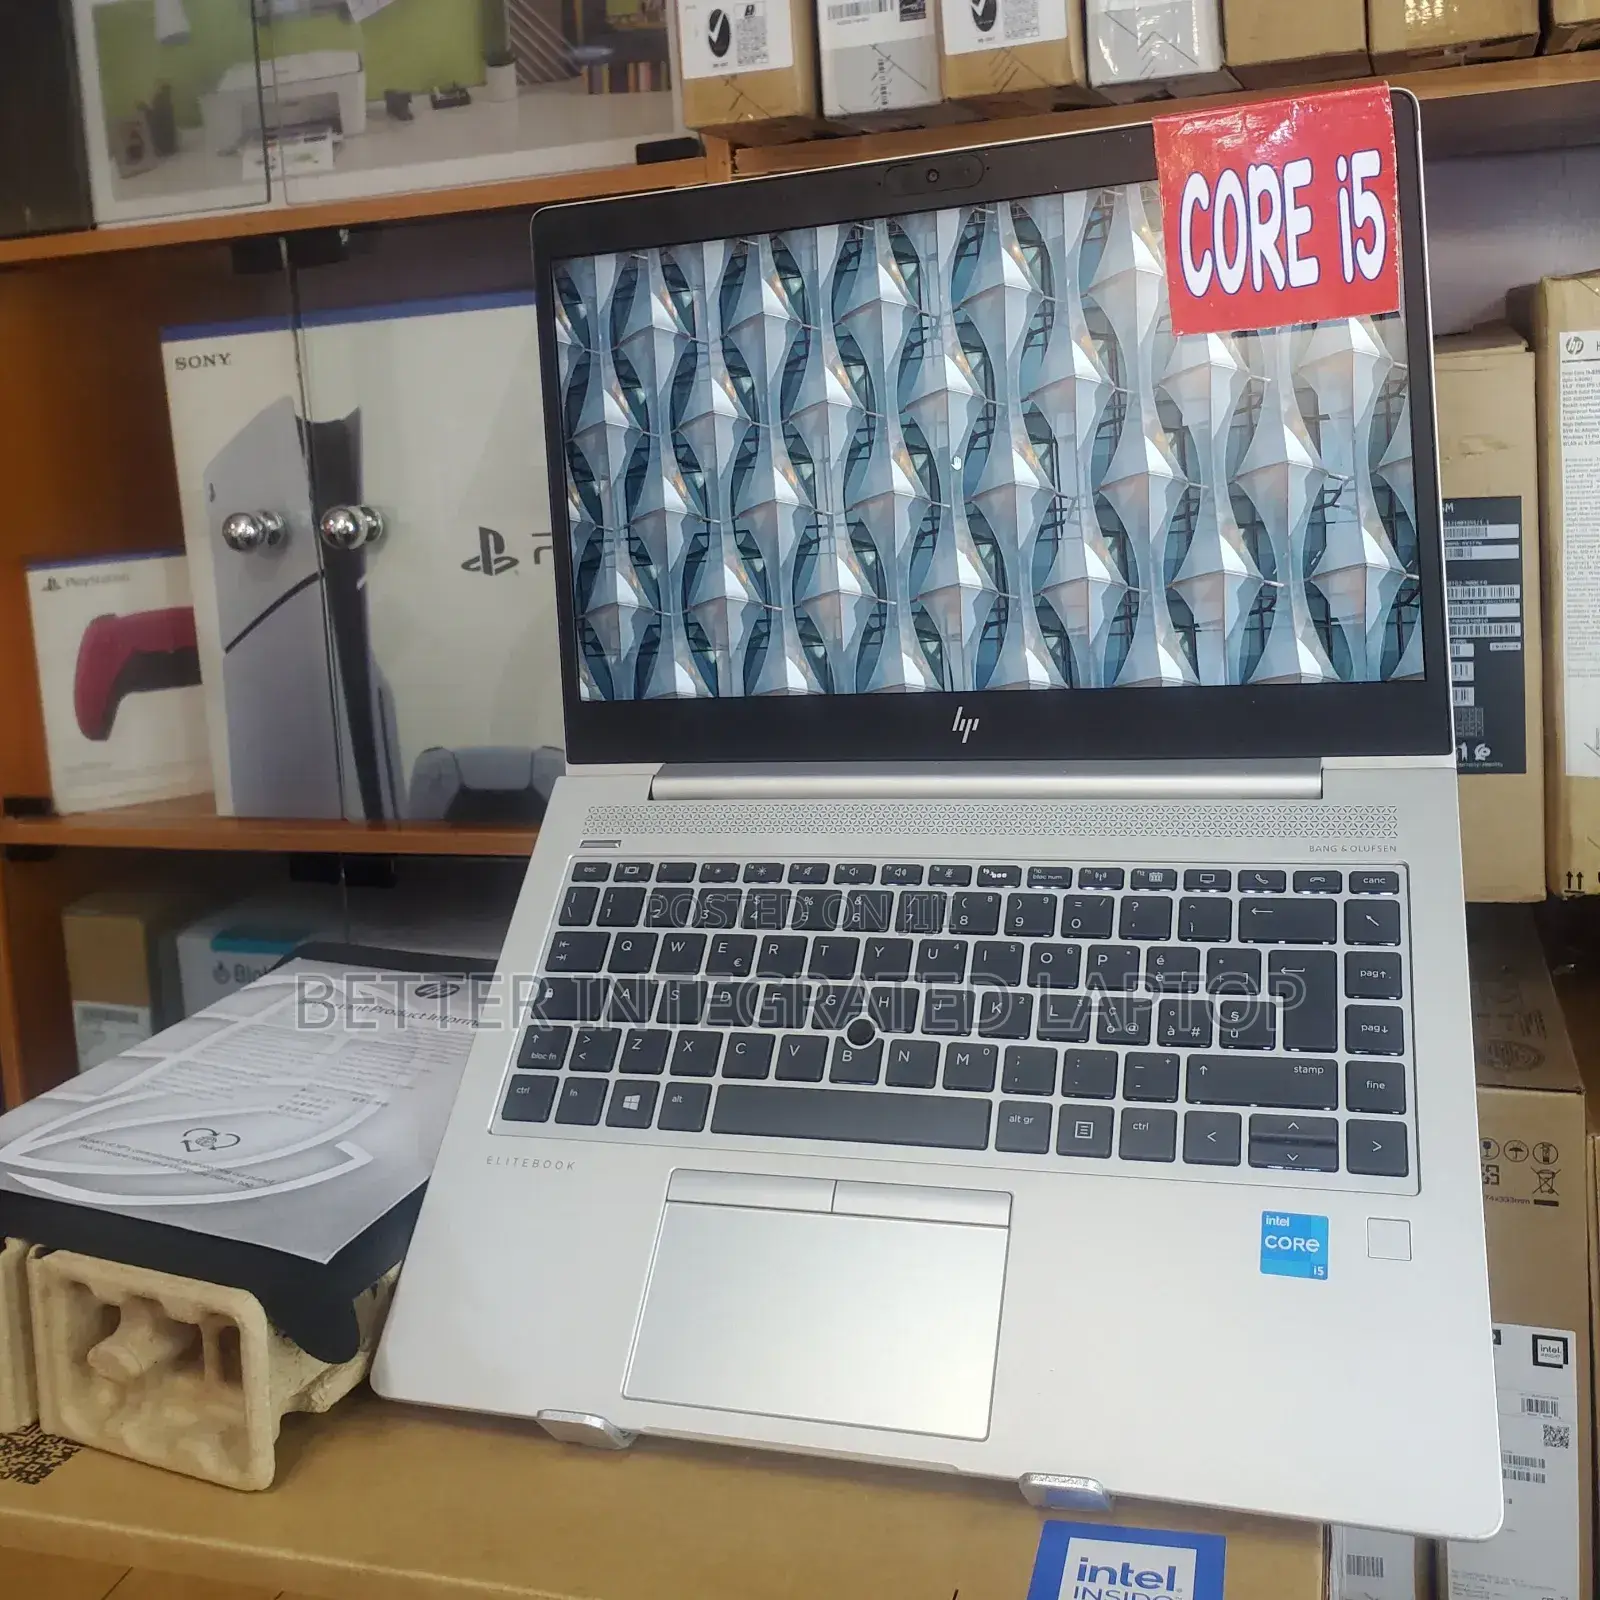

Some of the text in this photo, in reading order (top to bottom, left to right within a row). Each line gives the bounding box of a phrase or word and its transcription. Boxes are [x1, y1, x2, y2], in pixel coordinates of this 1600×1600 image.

[1179, 149, 1387, 298] CORE i5
[175, 352, 232, 370] SONY
[952, 706, 979, 743] hp
[805, 897, 813, 906] %
[855, 896, 862, 906] &
[701, 910, 709, 919] 3
[750, 911, 758, 919] 4
[852, 913, 860, 922] 6
[959, 916, 968, 925] 8
[1015, 917, 1024, 926] 9
[621, 940, 632, 951] Q
[671, 941, 685, 952] W
[718, 942, 728, 953] E
[768, 944, 779, 954] R
[820, 946, 829, 956] T
[875, 947, 884, 958] Y
[928, 948, 938, 959] U
[1041, 952, 1053, 963] O
[734, 958, 743, 967] €
[1098, 955, 1108, 965] P
[620, 988, 631, 999] A
[671, 990, 680, 1001] S
[720, 992, 731, 1002] D
[772, 993, 781, 1003] F
[826, 995, 836, 1006] G
[879, 996, 890, 1008] H
[934, 1000, 942, 1011] J
[369, 1005, 426, 1020] Product
[992, 1003, 1002, 1014] K
[1050, 1005, 1058, 1017] L
[1126, 1023, 1138, 1034] @
[1191, 1027, 1200, 1036] #
[632, 1039, 642, 1050] Z
[683, 1041, 694, 1052] X
[736, 1043, 746, 1054] C
[531, 1052, 548, 1060] bloc
[790, 1045, 800, 1056] V
[842, 1051, 852, 1062] B
[899, 1051, 910, 1062] N
[957, 1054, 969, 1066] M
[1293, 1065, 1324, 1075] stamp
[1366, 1080, 1385, 1089] fine
[1009, 1115, 1021, 1123] alt
[486, 1156, 576, 1170] ELITEBOOK
[1266, 1215, 1289, 1227] intel
[1314, 1266, 1324, 1276] i5
[1077, 1557, 1176, 1591] intel
